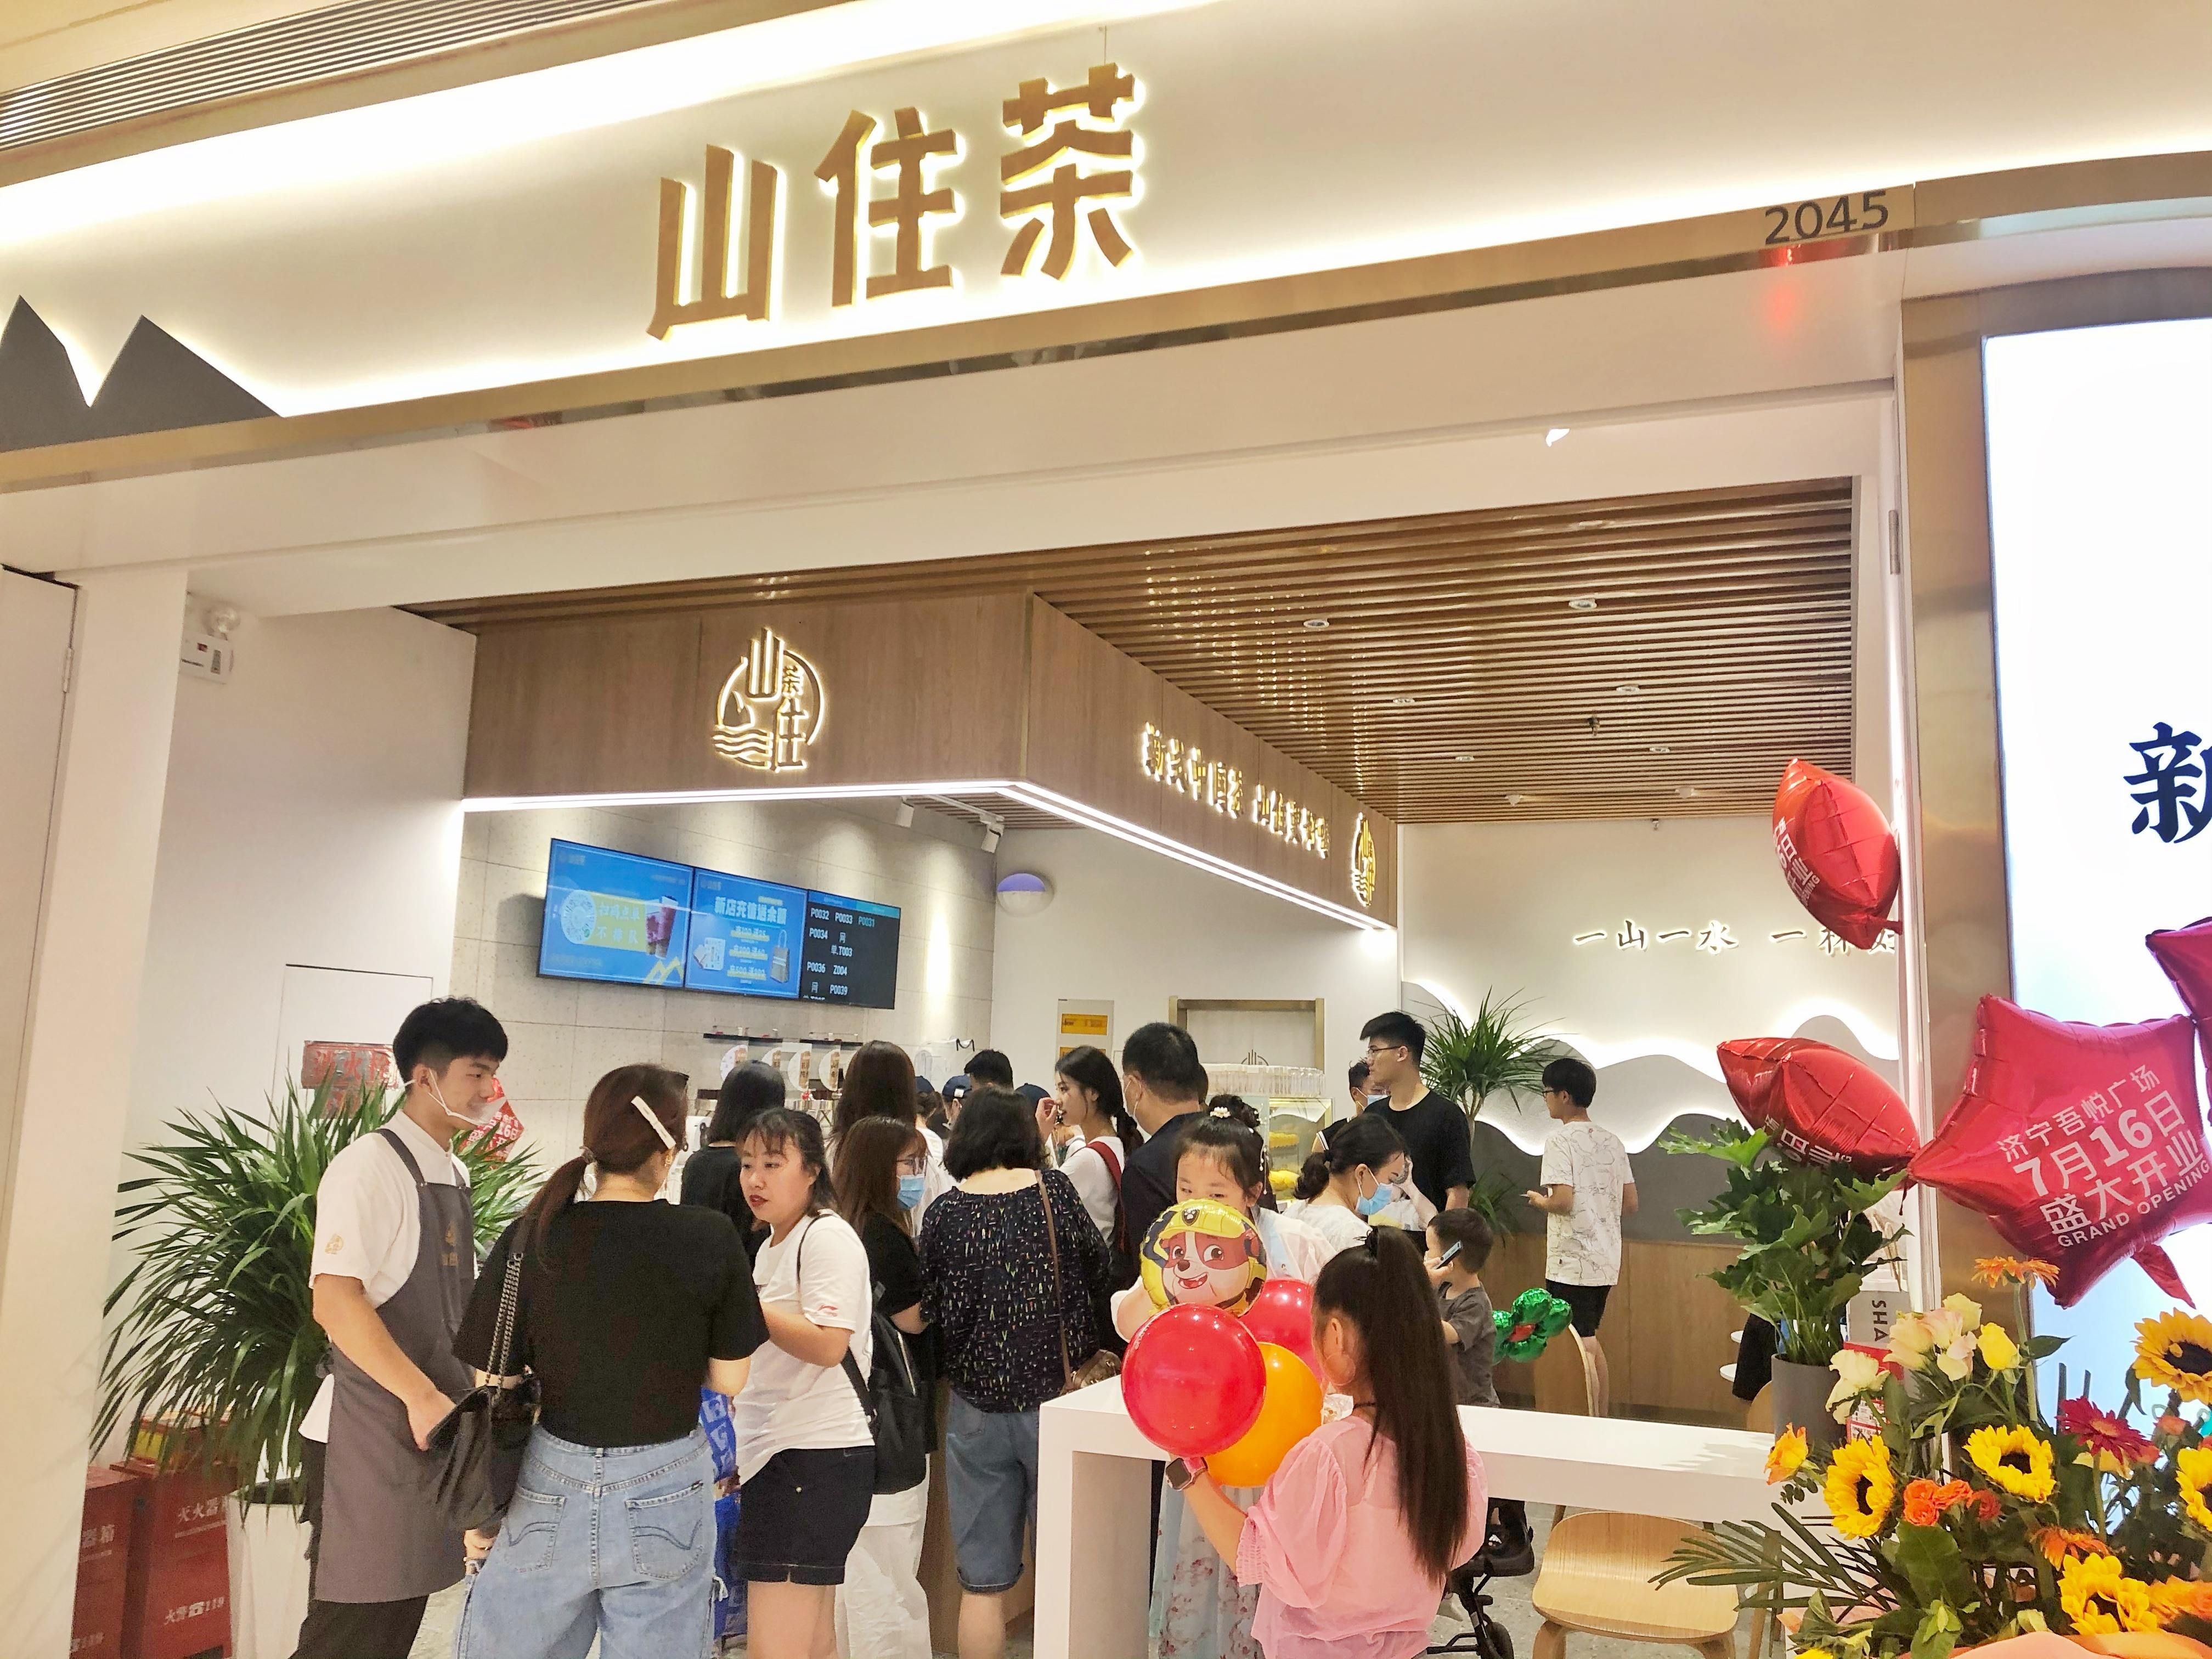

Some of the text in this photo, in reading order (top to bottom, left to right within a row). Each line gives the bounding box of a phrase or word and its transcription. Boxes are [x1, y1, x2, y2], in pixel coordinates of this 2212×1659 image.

[646, 63, 1135, 340] 山住茶
[1765, 190, 1888, 245] 2045
[1575, 920, 1737, 951] 一山一水
[1997, 1064, 2160, 1163] 济宁吾悦广场
[2013, 1090, 2186, 1197] 7月16日
[2040, 1130, 2203, 1235] 盛大开业
[2057, 1159, 2210, 1248] GRAND OPENING
